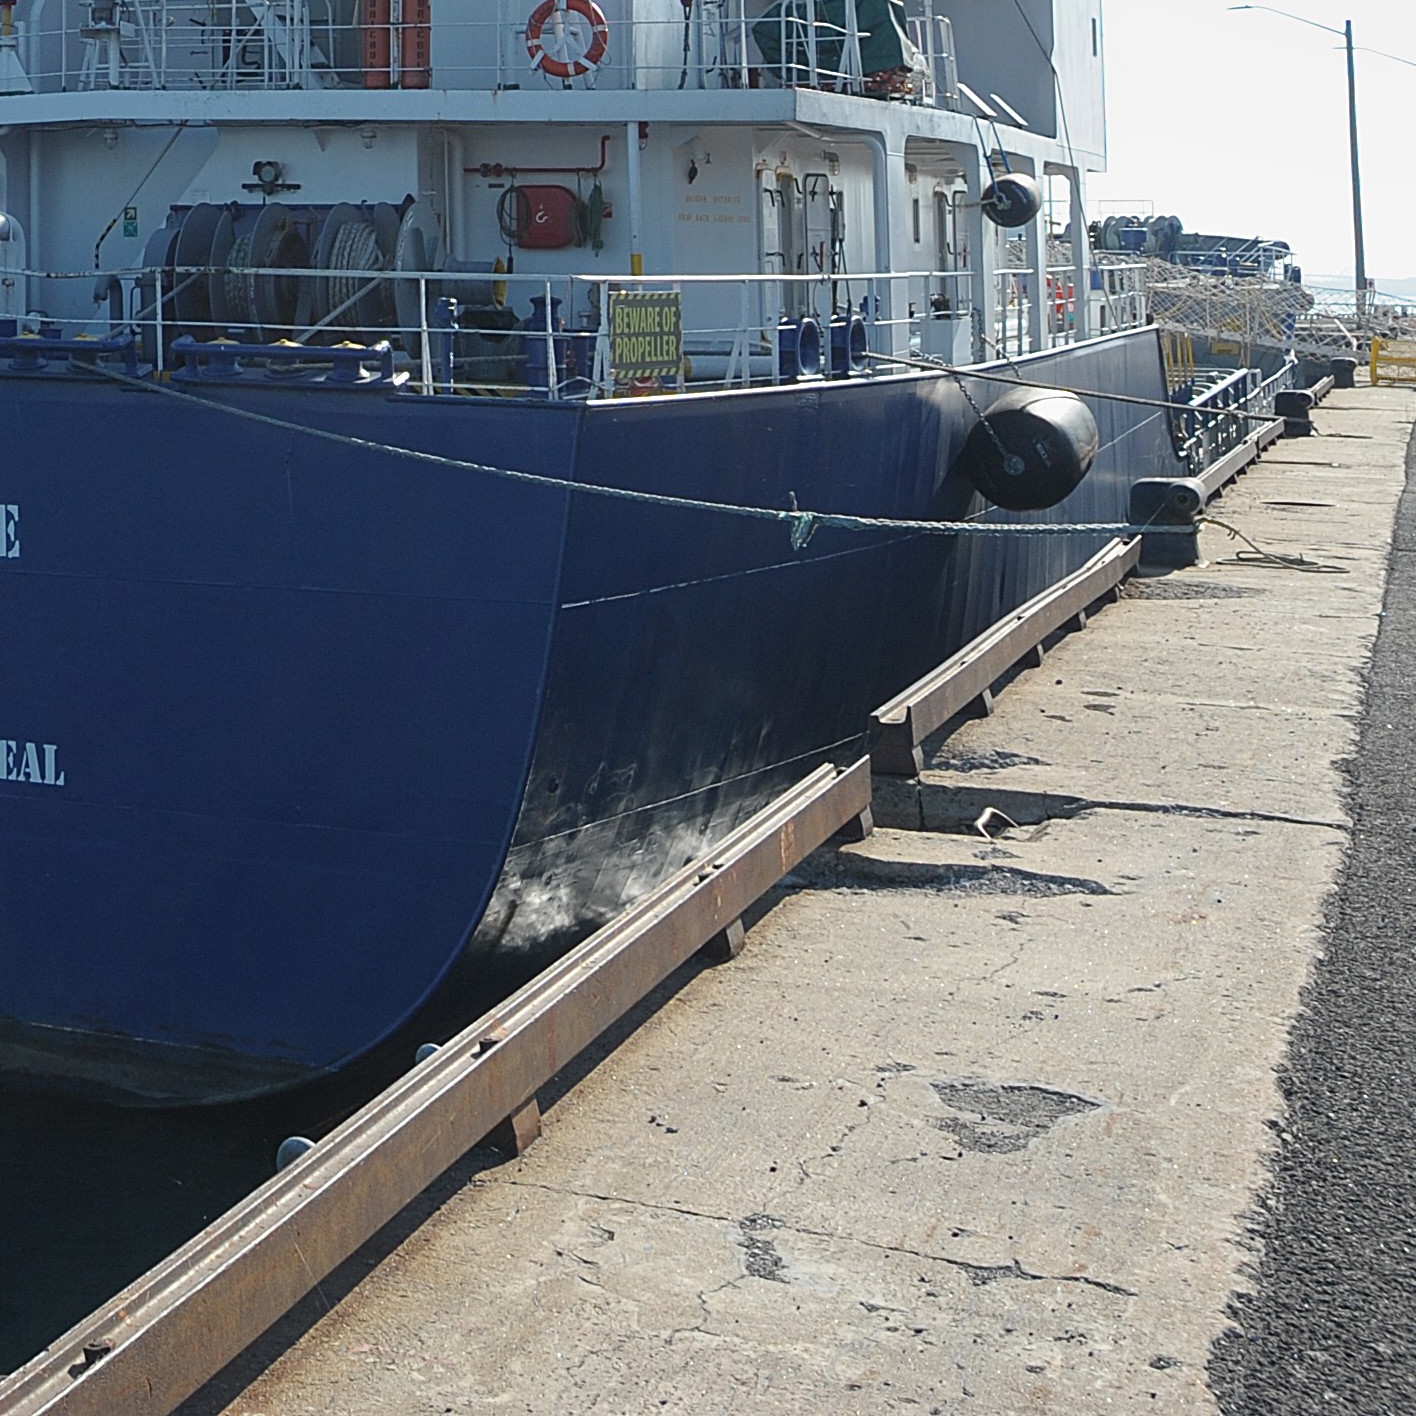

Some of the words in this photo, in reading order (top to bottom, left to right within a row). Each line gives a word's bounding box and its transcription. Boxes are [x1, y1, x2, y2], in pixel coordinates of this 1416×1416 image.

[615, 307, 660, 334] BEWARE
[662, 306, 676, 332] OF
[615, 335, 677, 364] PROPELLER
